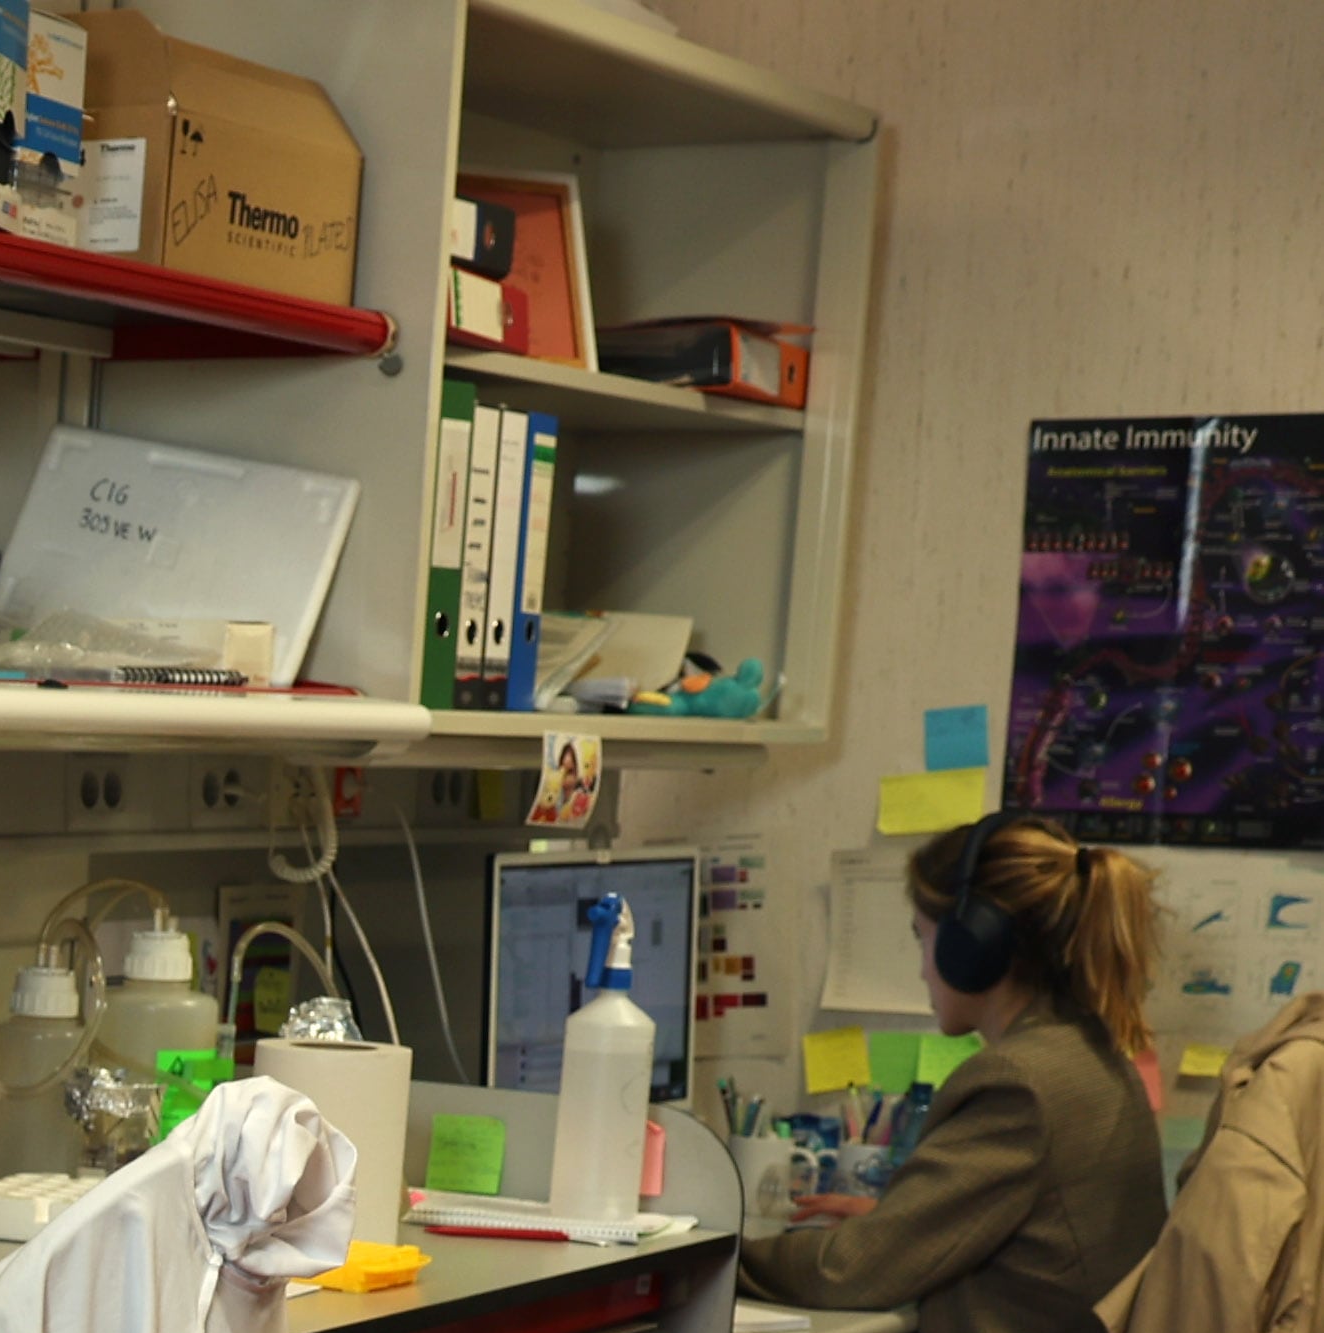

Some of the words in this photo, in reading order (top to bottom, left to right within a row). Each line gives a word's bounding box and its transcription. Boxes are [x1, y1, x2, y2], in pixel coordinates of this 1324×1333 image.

[228, 190, 299, 239] Thermo
[227, 230, 297, 258] SCIENTIFIC
[1033, 426, 1120, 450] Innate
[1126, 423, 1257, 453] Immunity
